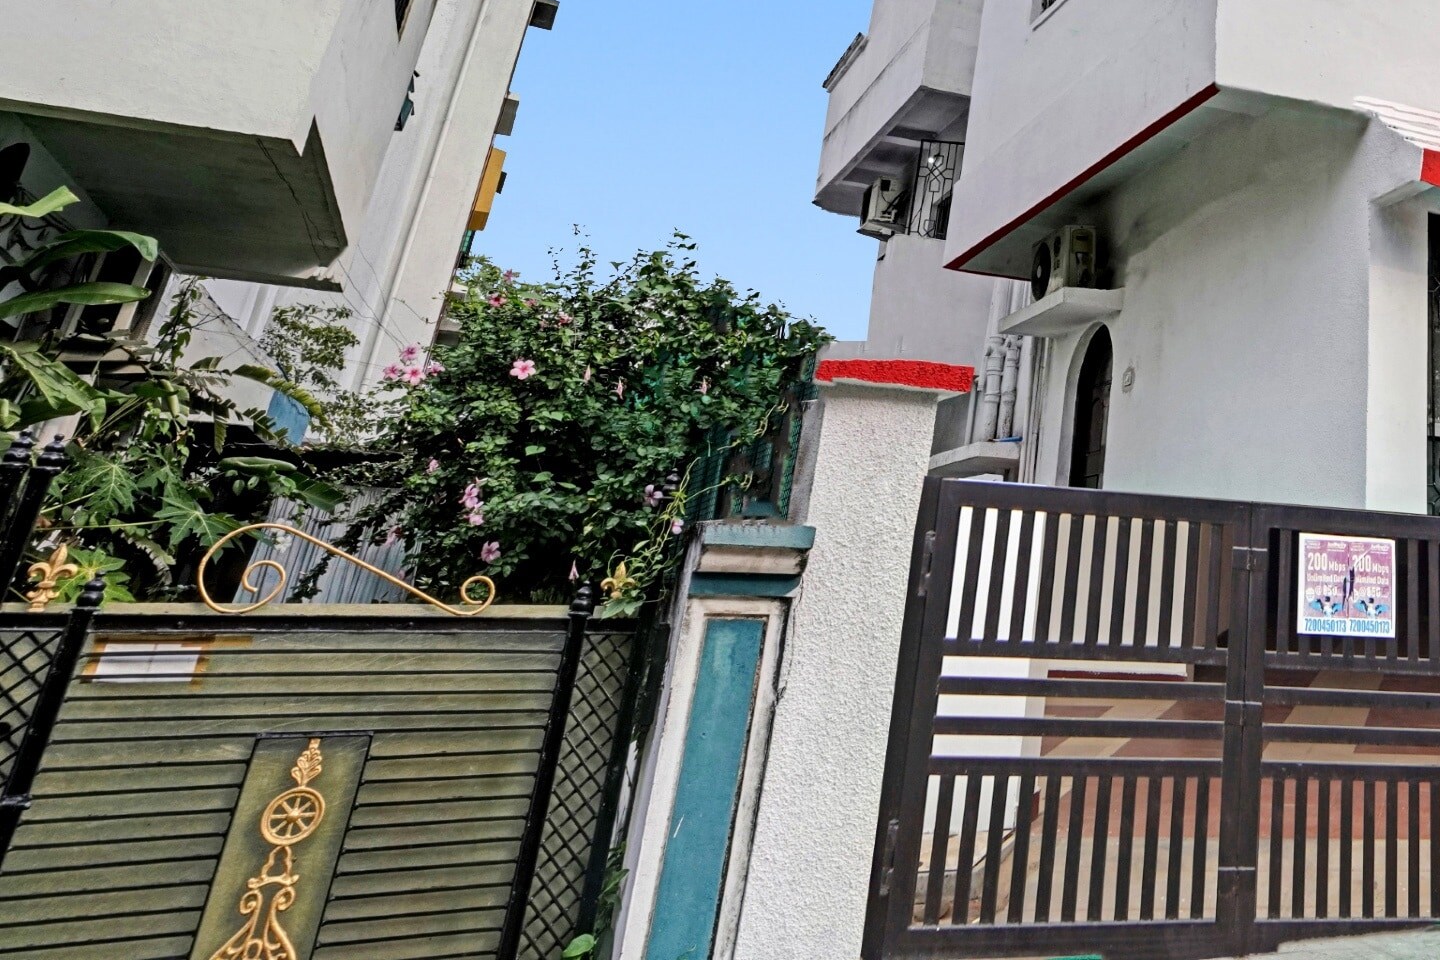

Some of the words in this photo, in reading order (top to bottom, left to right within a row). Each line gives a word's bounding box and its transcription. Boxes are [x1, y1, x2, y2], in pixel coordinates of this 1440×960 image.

[1307, 552, 1328, 571] 200
[1328, 561, 1346, 573] Mbps
[1352, 554, 1371, 572] 200
[1372, 563, 1390, 575] Mbps
[1304, 618, 1347, 633] 7200450173
[1350, 619, 1390, 634] 7200450173
